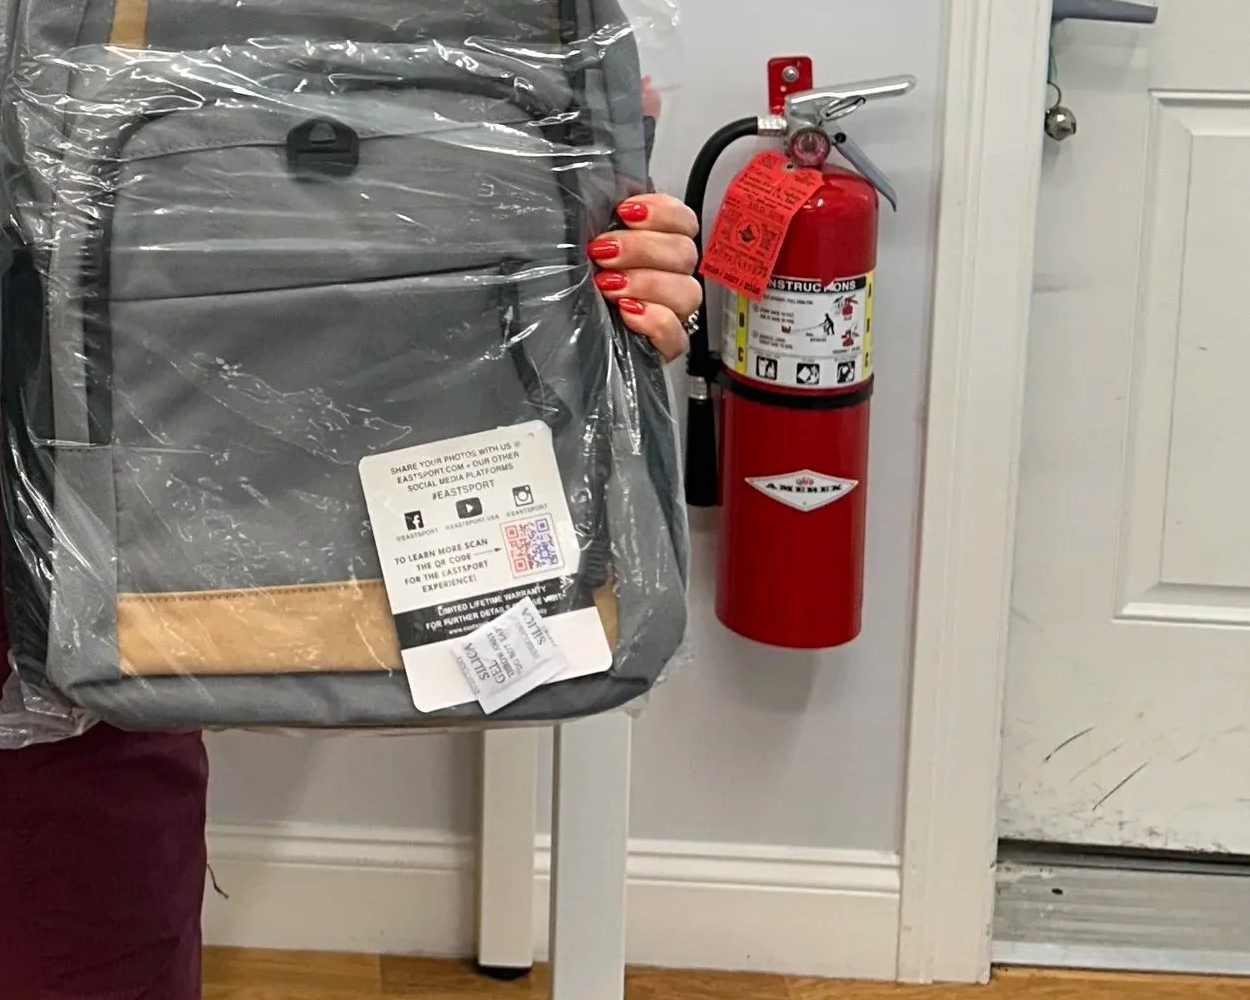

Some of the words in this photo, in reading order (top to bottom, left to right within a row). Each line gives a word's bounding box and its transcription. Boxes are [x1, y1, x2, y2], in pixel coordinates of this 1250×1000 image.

[390, 463, 418, 475] SHARE
[419, 457, 443, 469] YOUR
[443, 450, 477, 463] PHOTOS
[478, 445, 499, 456] WITH
[500, 442, 512, 451] US
[472, 456, 491, 467] OUR
[491, 450, 520, 463] OTHER
[407, 480, 437, 492] SOCIAL
[439, 473, 464, 485] MEDIA
[466, 463, 514, 479] PLATFORMS
[432, 479, 495, 500] #EASTSPORT
[394, 557, 406, 565] TO
[408, 549, 436, 562] LEARN
[438, 543, 462, 555] MORE
[464, 538, 488, 549] SCAN
[416, 561, 432, 572] THE
[434, 558, 447, 568] QR
[449, 553, 471, 564] CODE
[404, 576, 421, 585] FOR
[423, 571, 439, 581] THE
[442, 560, 489, 577] EASTSPORT
[438, 603, 468, 616] LIMITED
[470, 595, 503, 610] LIFETIME
[504, 586, 547, 601] WARRANTY
[426, 621, 442, 631] FOR
[443, 611, 479, 627] FURTHER
[521, 606, 547, 646] SILICA
[463, 642, 490, 681] SILICA
[489, 659, 507, 684] GEL
